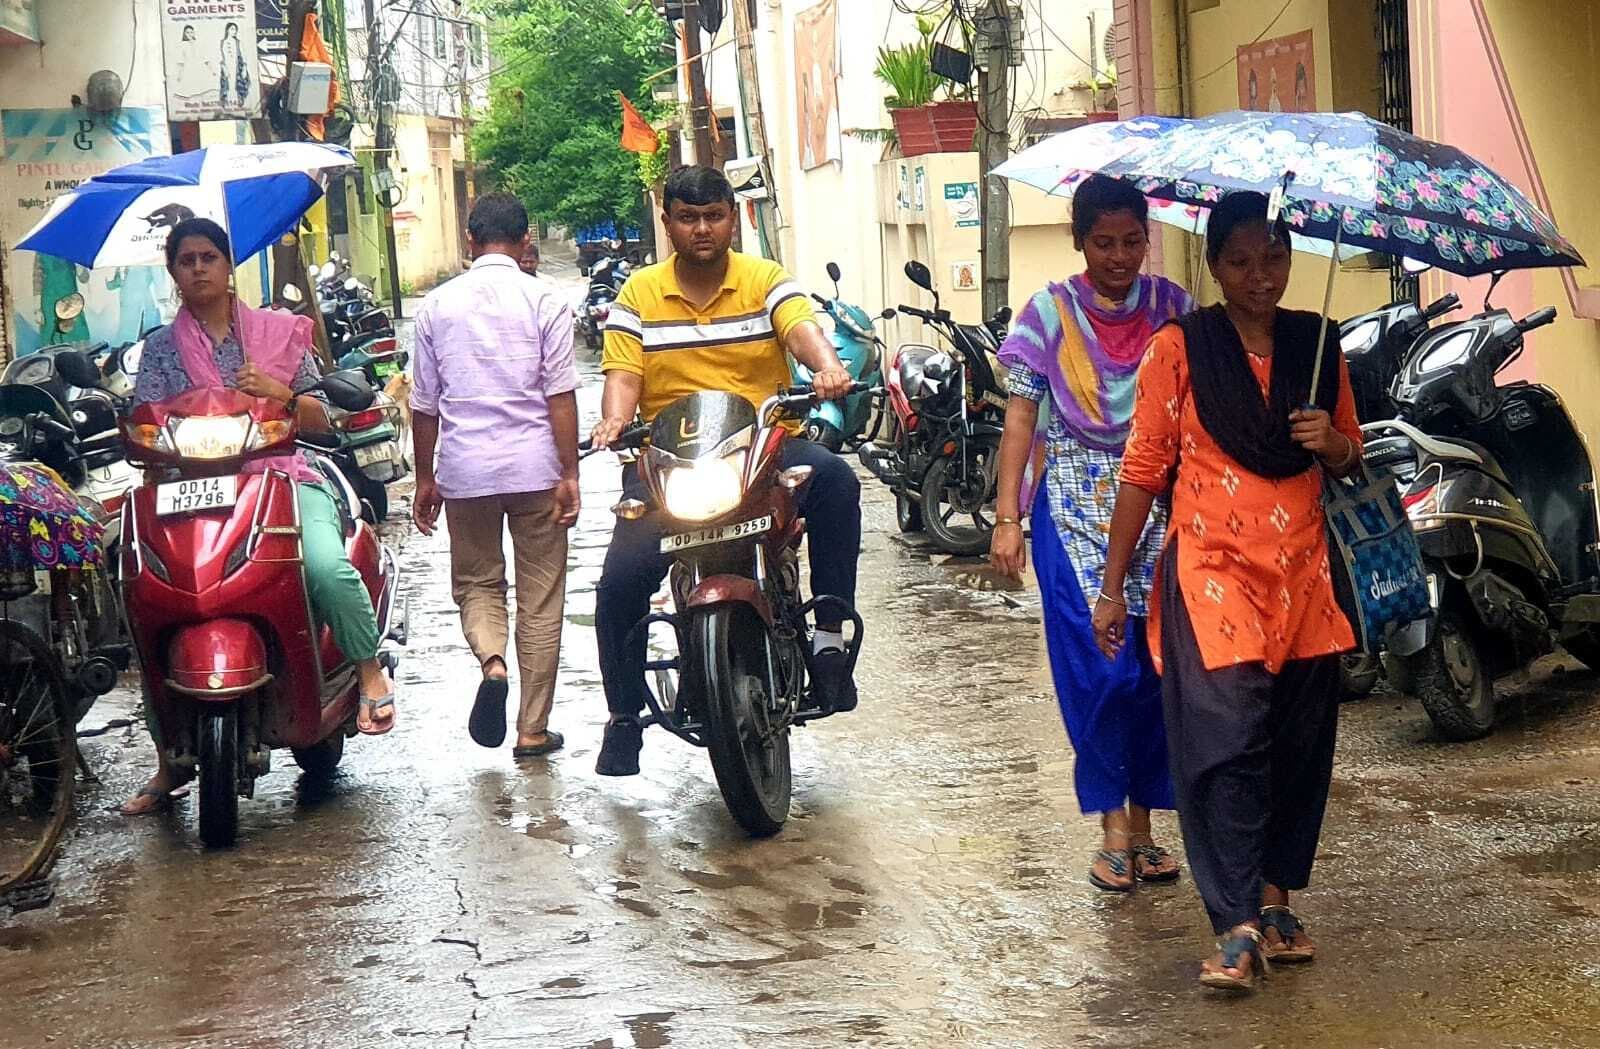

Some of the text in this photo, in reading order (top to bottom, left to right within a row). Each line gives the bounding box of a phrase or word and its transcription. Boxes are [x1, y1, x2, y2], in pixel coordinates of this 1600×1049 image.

[167, 4, 246, 15] GARMENTS
[45, 180, 51, 190] A
[1362, 446, 1398, 460] HONDA
[734, 518, 767, 535] 9259
